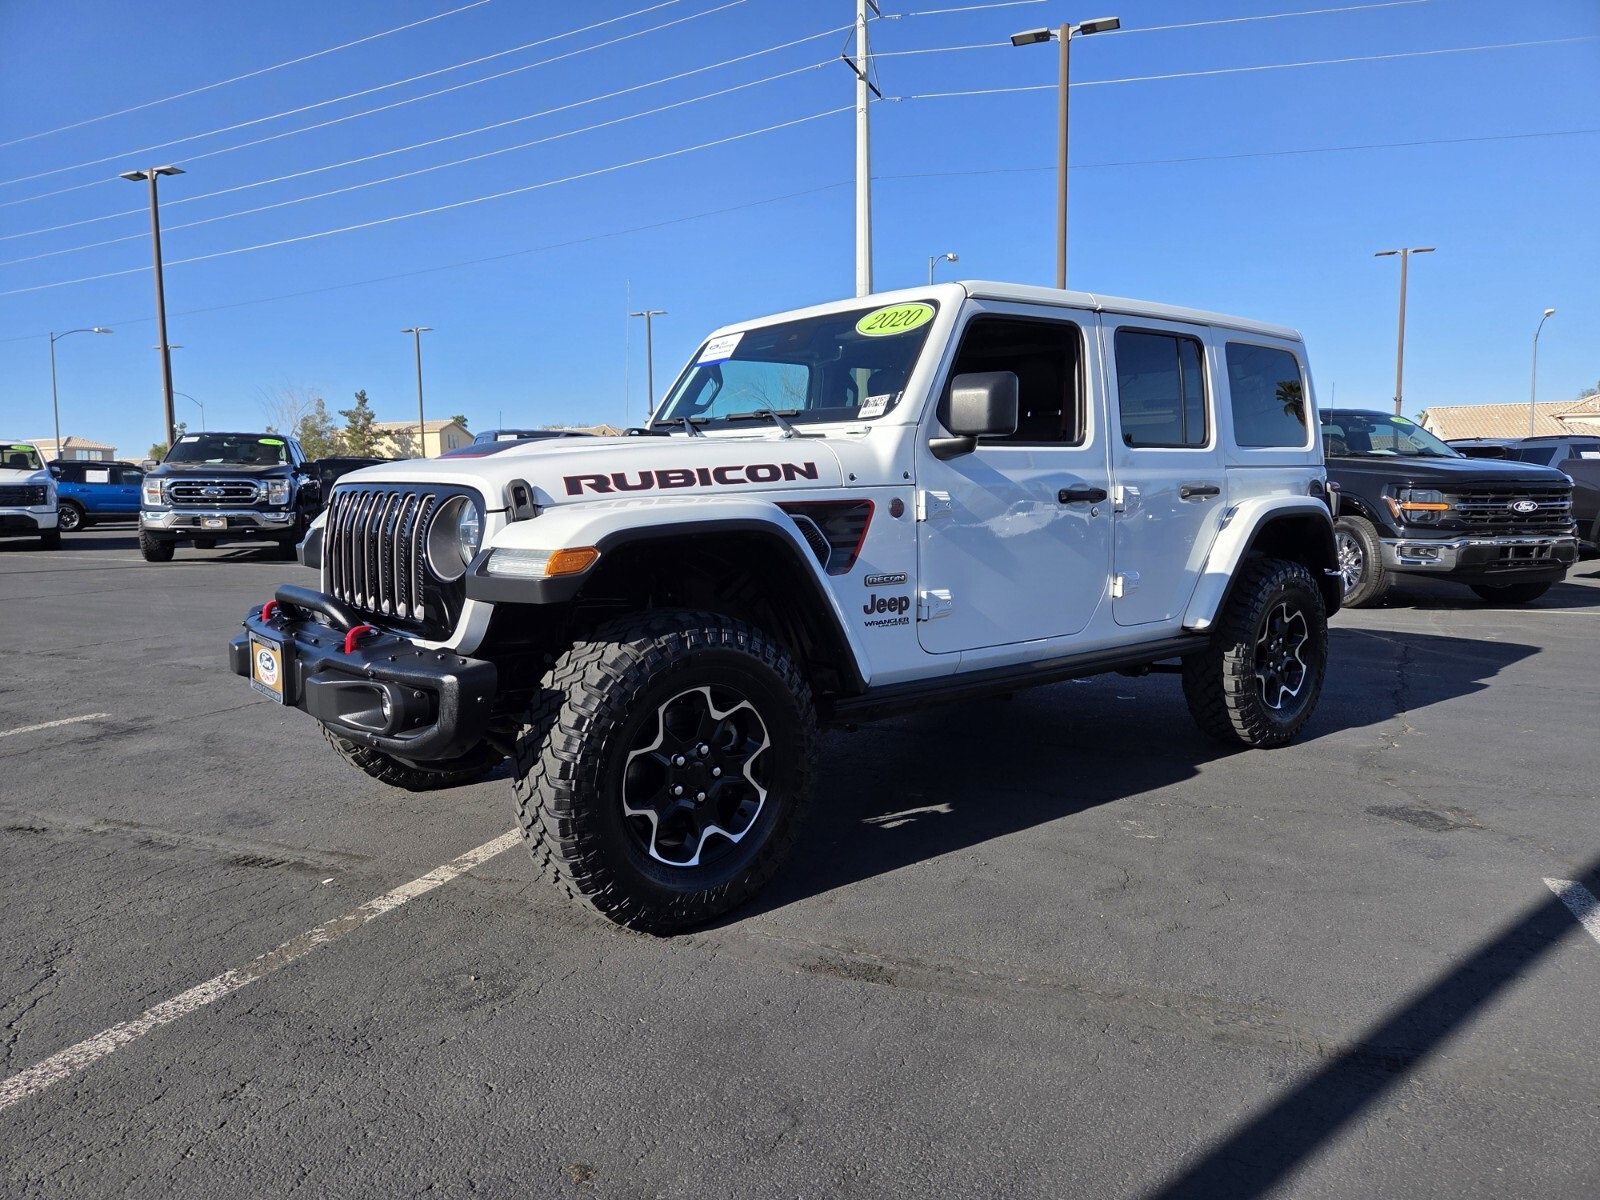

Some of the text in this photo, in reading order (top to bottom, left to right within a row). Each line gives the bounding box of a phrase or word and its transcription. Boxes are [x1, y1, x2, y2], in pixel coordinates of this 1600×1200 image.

[865, 308, 924, 331] 2020
[563, 461, 819, 496] RUBICON
[869, 575, 905, 584] RECON
[863, 593, 910, 615] Jeep
[864, 617, 909, 627] WRANGLER
